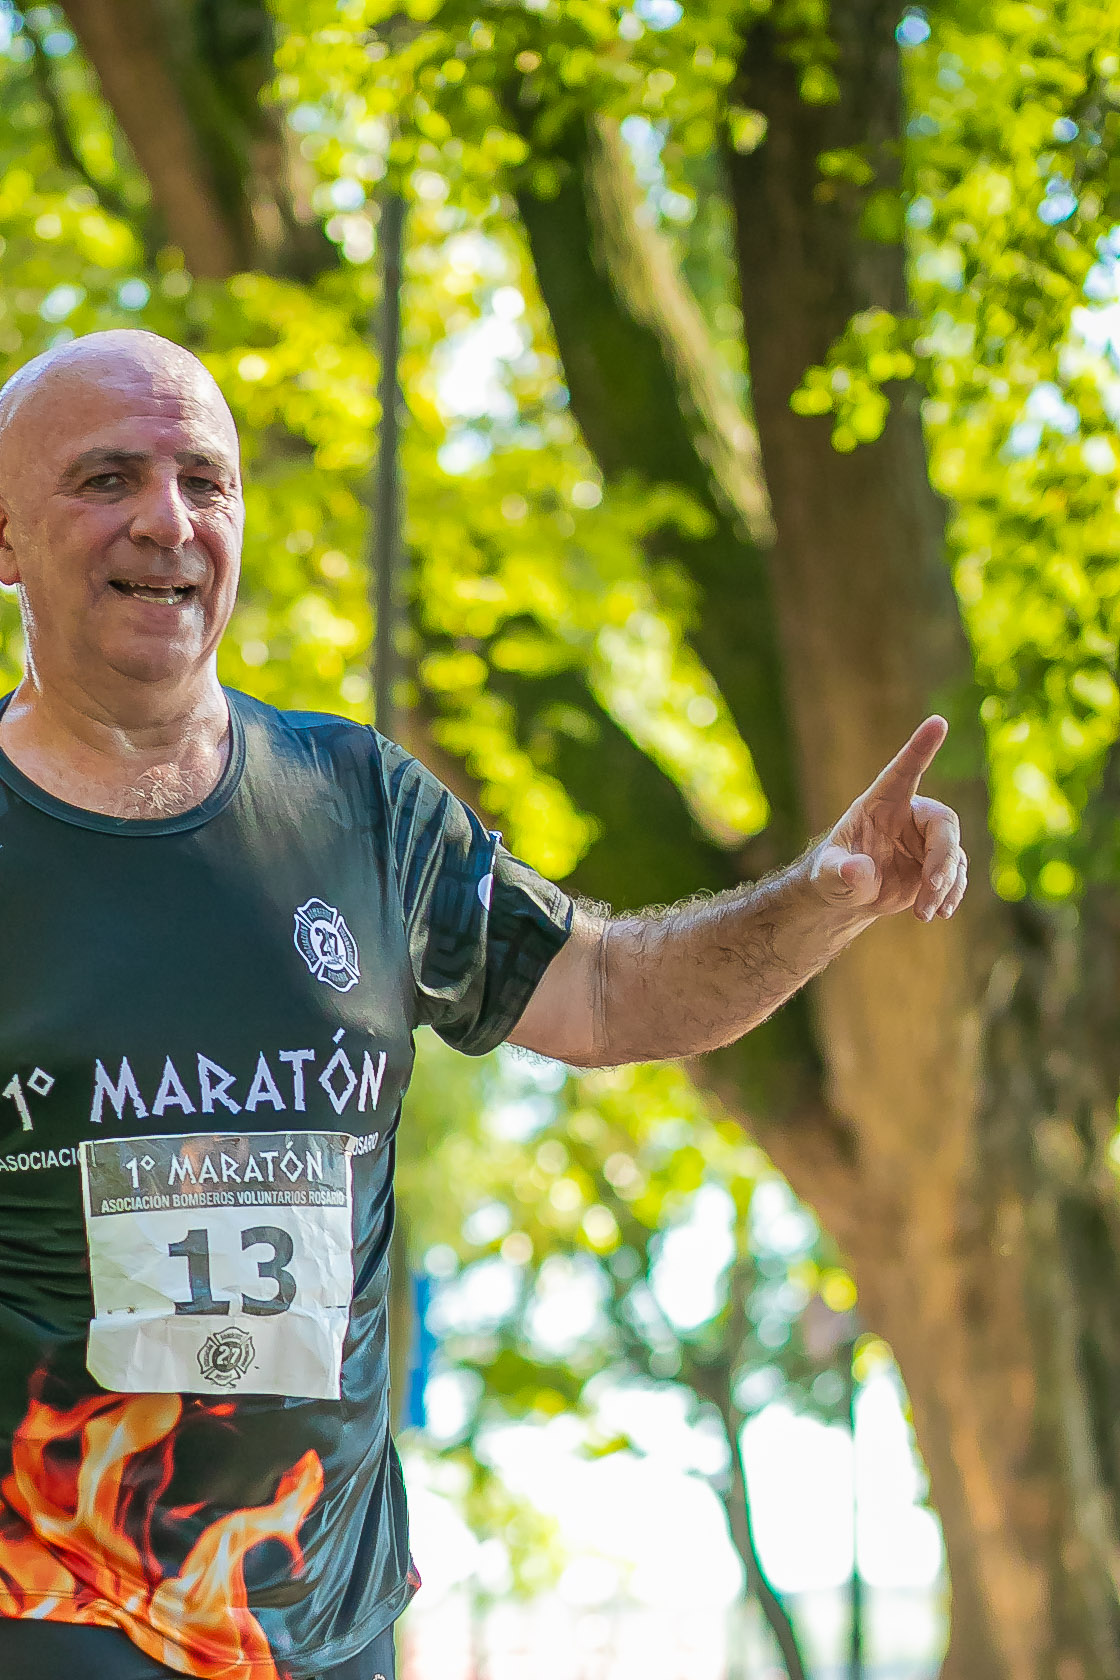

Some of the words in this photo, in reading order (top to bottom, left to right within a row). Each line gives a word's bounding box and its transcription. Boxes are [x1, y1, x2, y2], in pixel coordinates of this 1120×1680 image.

[89, 1027, 388, 1124] MARATÓN
[167, 1142, 323, 1185] MARATÓN
[173, 1191, 235, 1208] BOMBEROS
[236, 1189, 307, 1205] VOLUNTARIOS
[308, 1189, 345, 1205] ROSARIO
[168, 1225, 297, 1316] 13
[216, 1345, 241, 1365] 27
